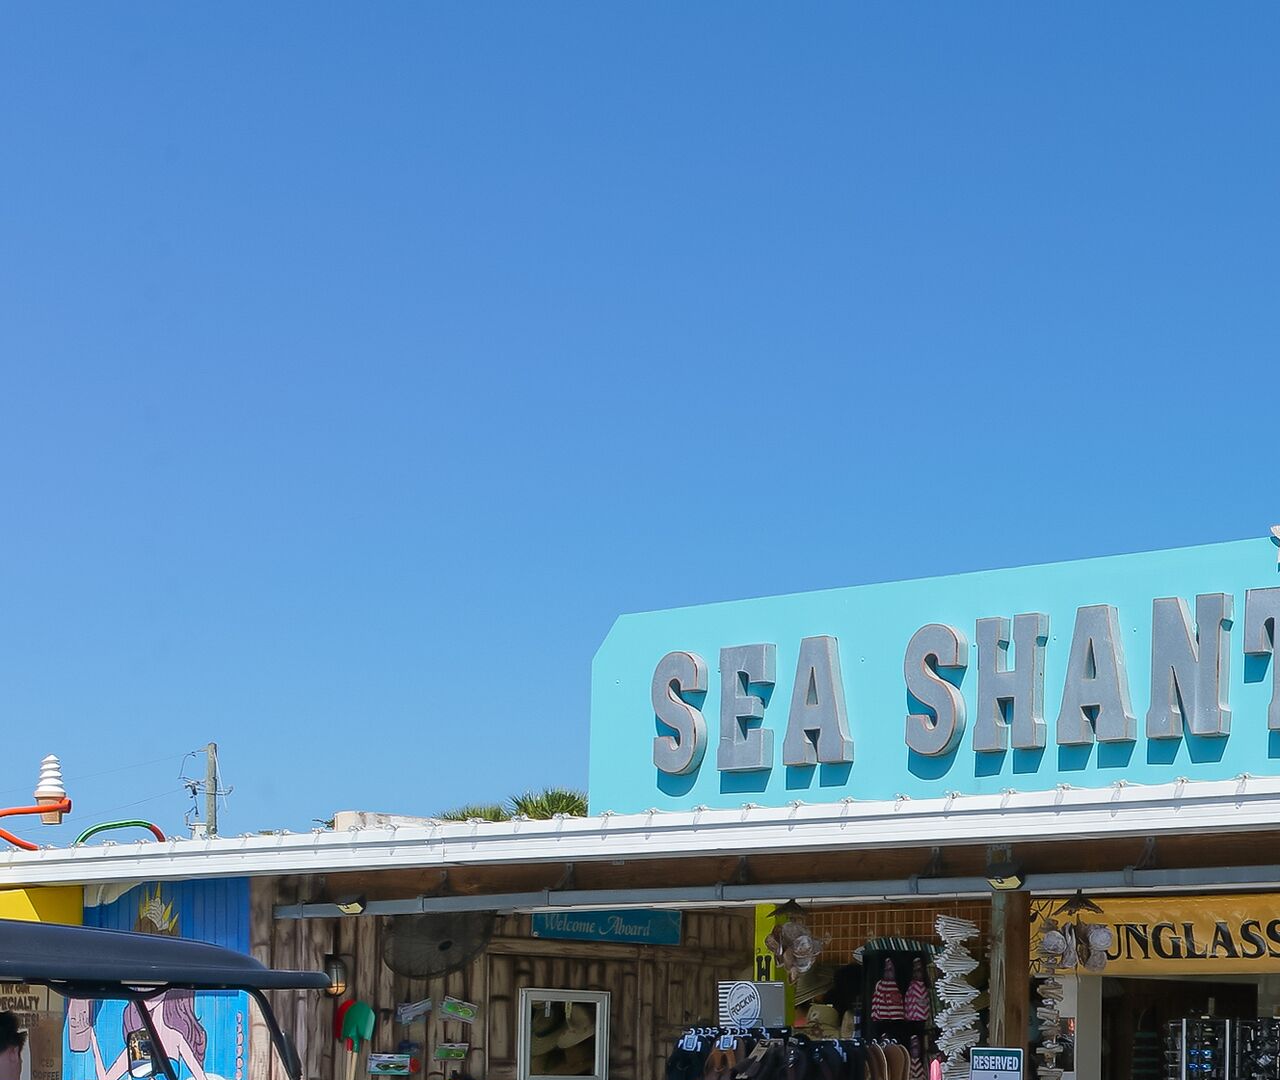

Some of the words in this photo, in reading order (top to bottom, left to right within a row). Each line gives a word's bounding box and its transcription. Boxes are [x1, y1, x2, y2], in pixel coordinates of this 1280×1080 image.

[651, 635, 856, 777] SEA
[542, 912, 596, 934] Welcome
[599, 915, 651, 937] Aboard
[730, 991, 756, 1016] ROCKIN
[33, 1070, 60, 1080] COFFEE
[973, 1055, 1019, 1071] RESERVED
